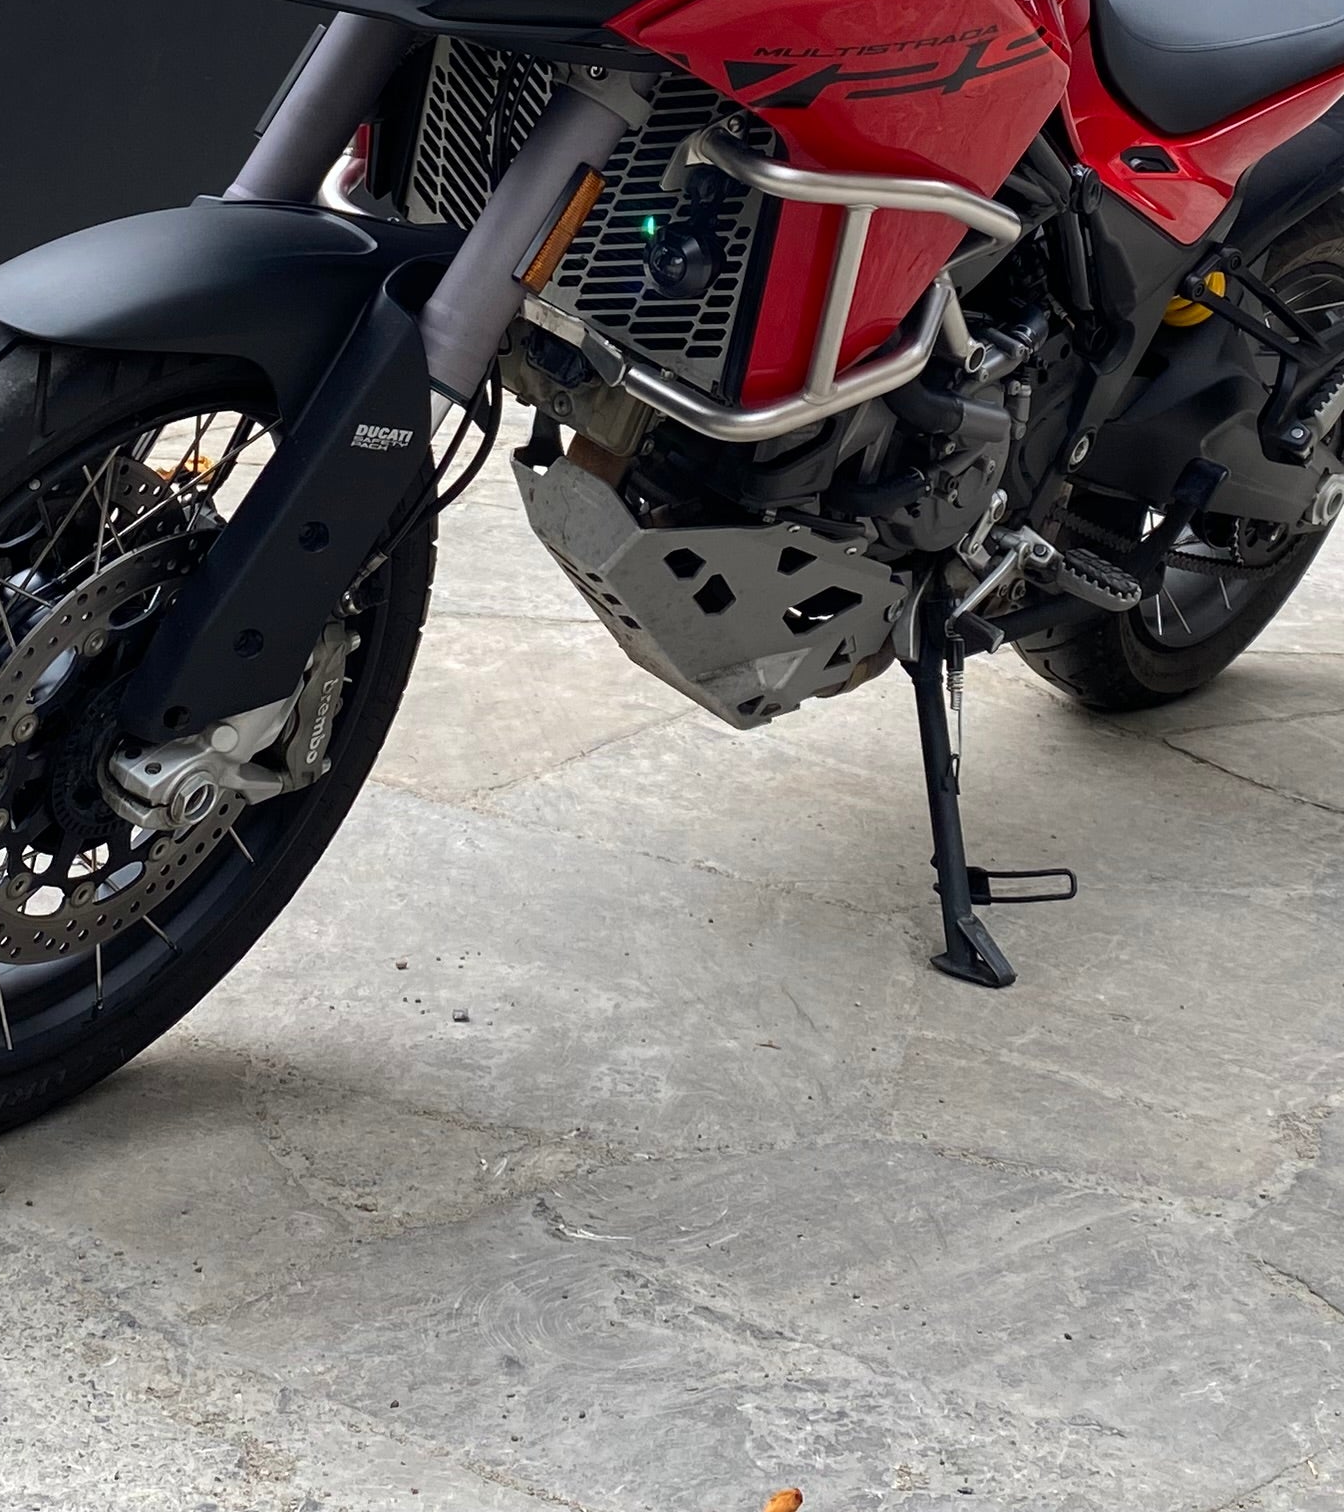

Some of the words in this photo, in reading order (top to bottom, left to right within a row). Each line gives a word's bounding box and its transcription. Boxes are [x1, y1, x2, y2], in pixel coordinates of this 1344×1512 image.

[753, 24, 1000, 58] MULTISTRADA
[355, 424, 414, 442] DUCATI
[306, 678, 339, 764] brembo
